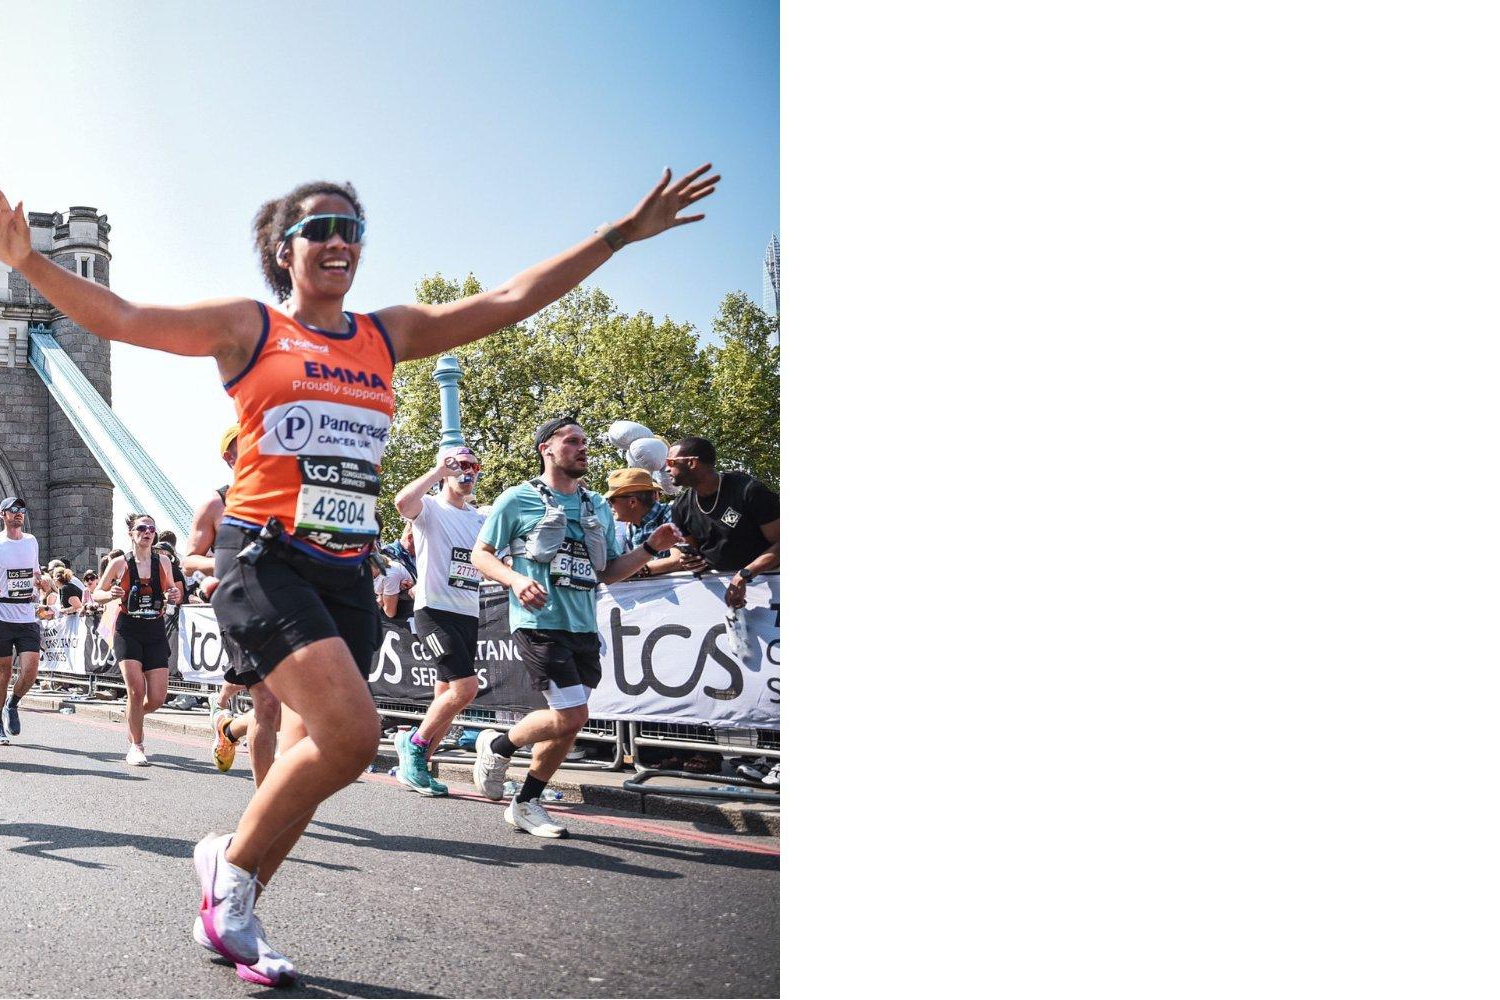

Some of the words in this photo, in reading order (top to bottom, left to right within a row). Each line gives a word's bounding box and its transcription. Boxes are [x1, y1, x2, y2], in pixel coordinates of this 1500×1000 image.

[304, 361, 387, 391] EMMA
[285, 416, 306, 440] P
[304, 460, 340, 484] tcs
[312, 496, 365, 526] 42804
[453, 549, 468, 561] tcs
[560, 557, 592, 577] 57488
[457, 564, 479, 578] 27737
[11, 580, 31, 589] 54290
[610, 606, 744, 701] tcs
